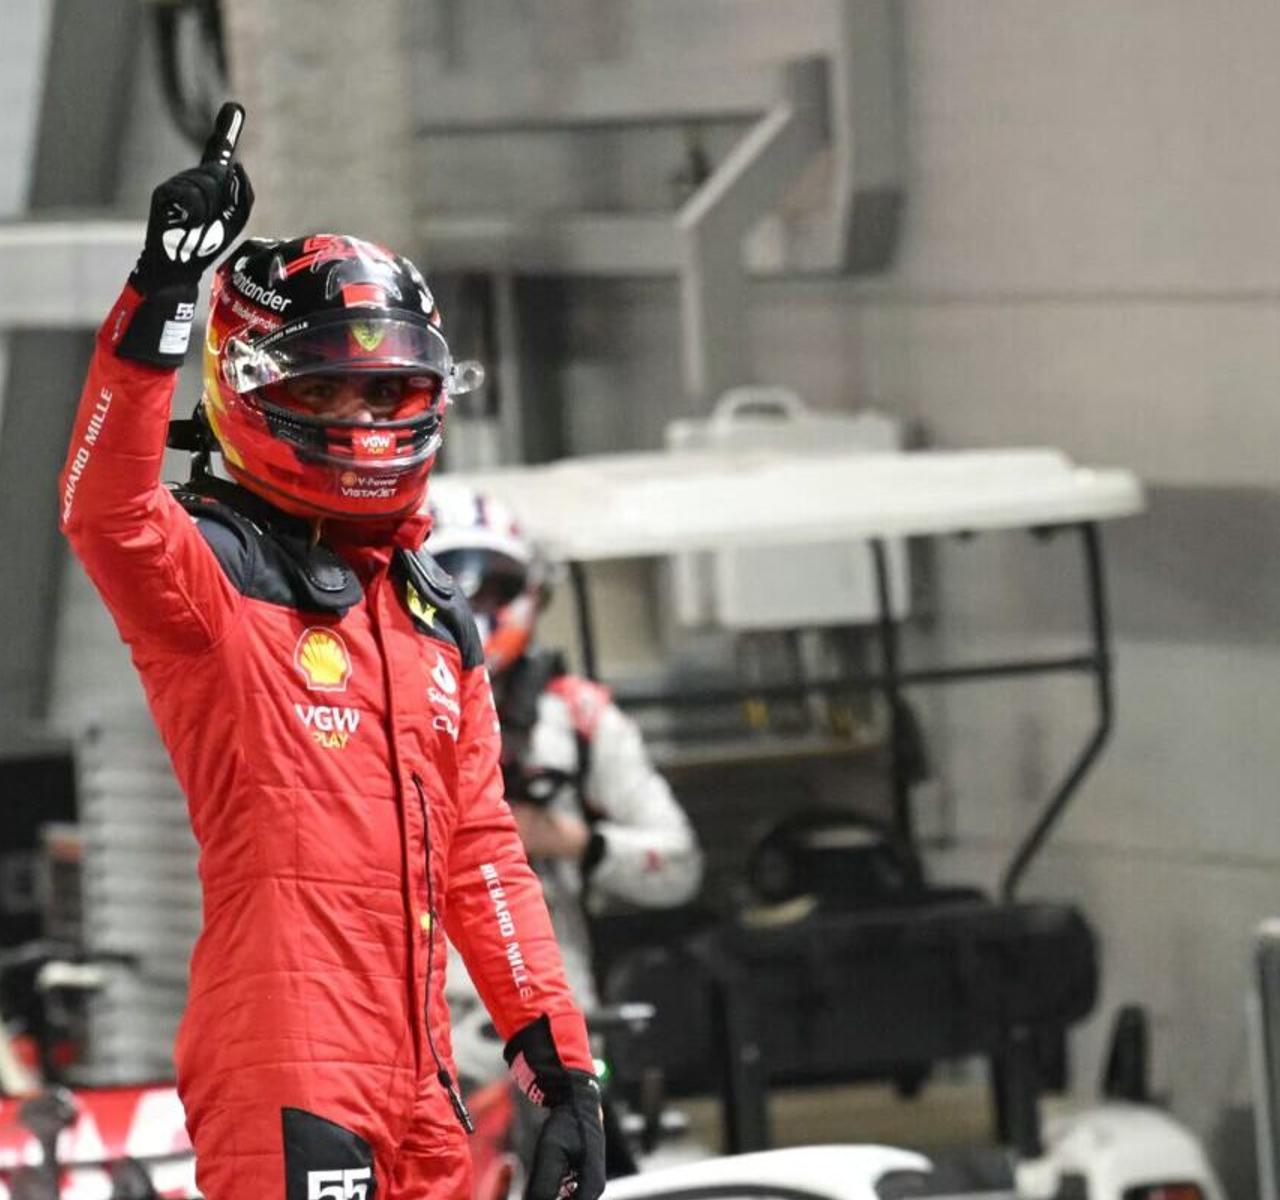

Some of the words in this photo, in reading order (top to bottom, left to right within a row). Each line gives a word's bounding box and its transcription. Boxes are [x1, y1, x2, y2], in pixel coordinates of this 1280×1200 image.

[294, 703, 361, 733] VGW
[312, 731, 350, 749] PLAY
[480, 863, 513, 938] RICHARD
